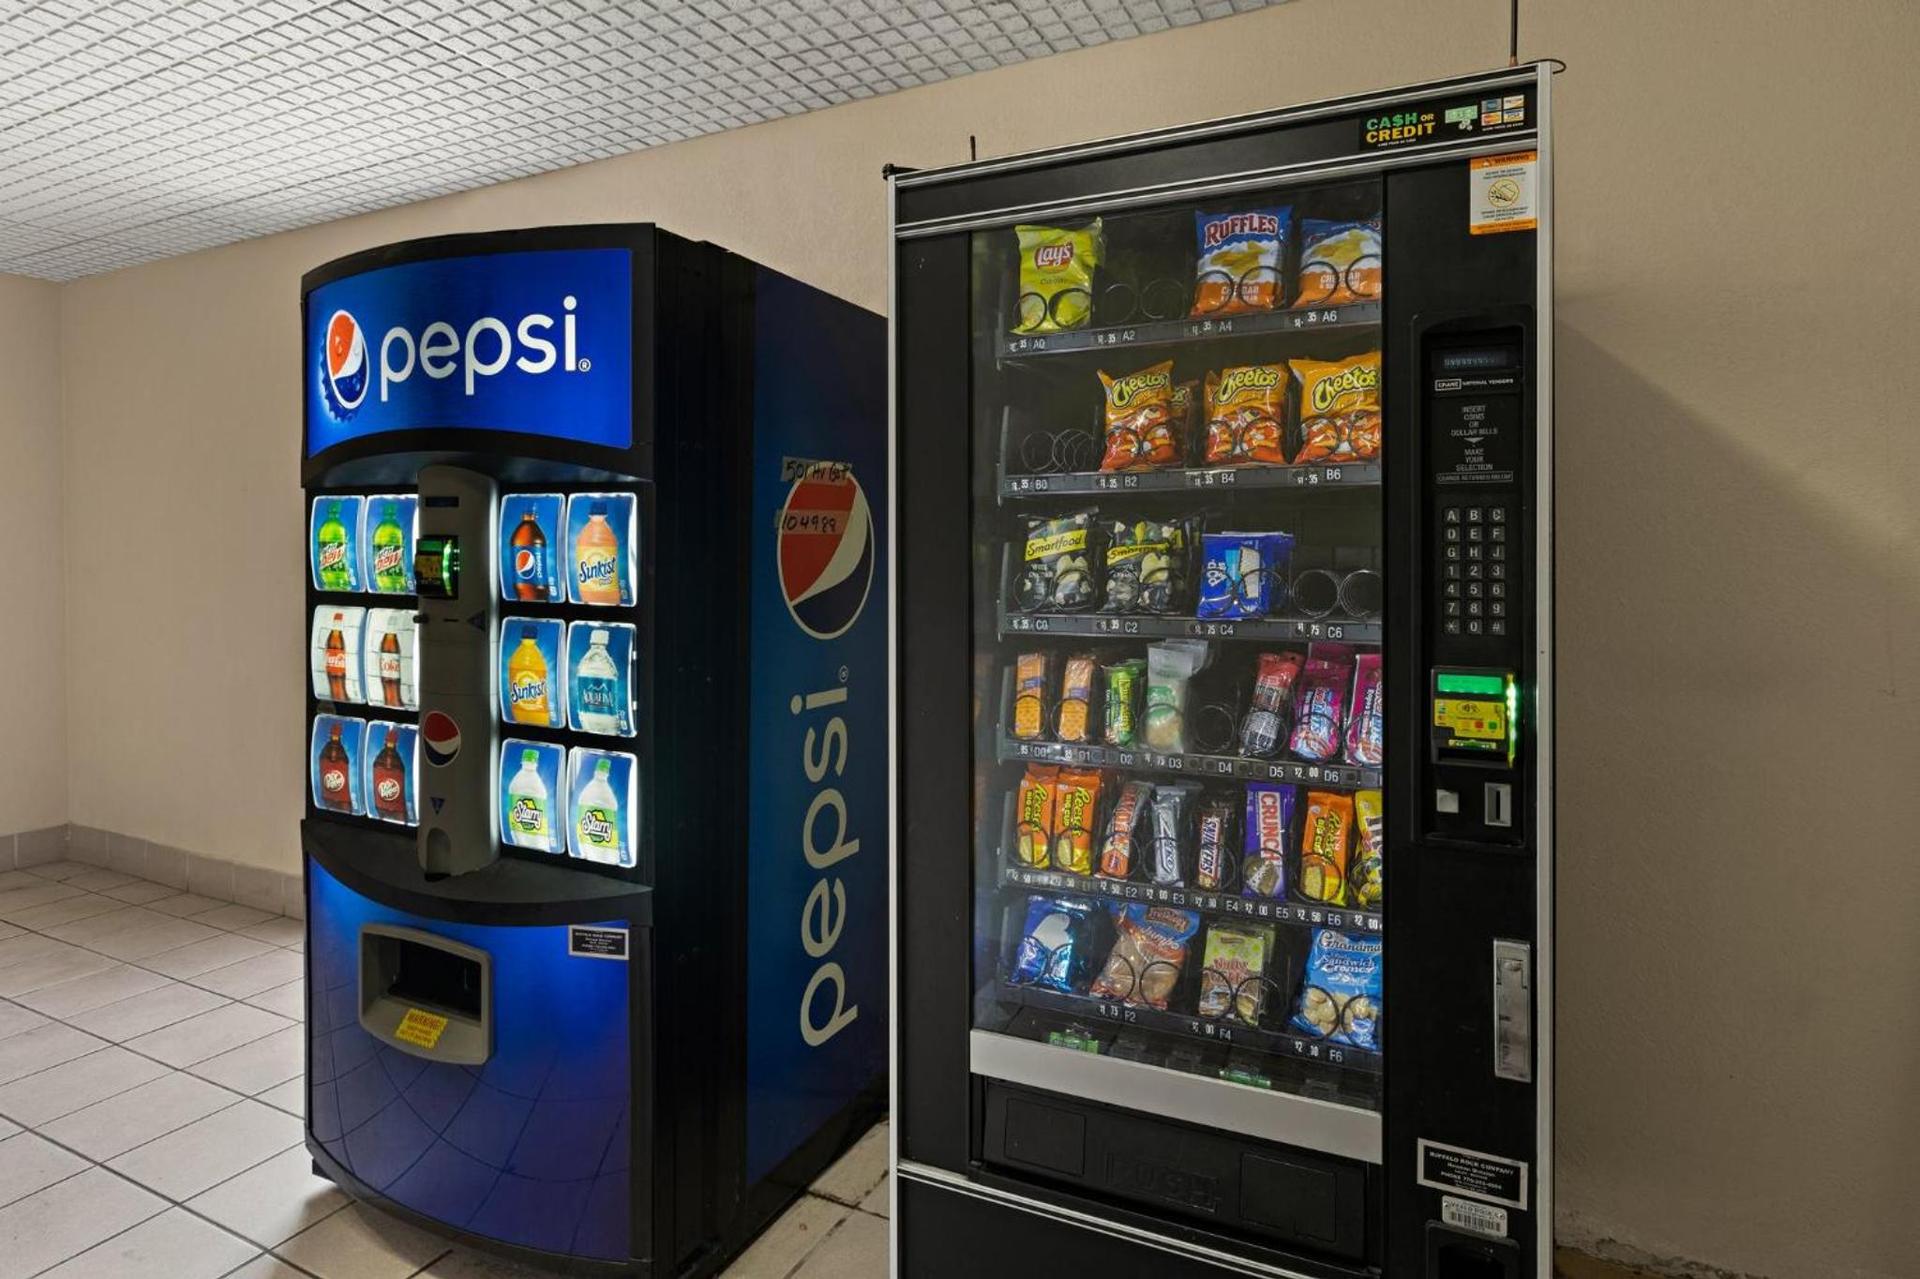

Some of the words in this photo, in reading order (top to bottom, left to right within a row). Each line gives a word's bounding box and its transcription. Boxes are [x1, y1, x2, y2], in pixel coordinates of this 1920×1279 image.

[1421, 113, 1434, 122] OR
[1366, 122, 1436, 143] CREDIT
[1204, 213, 1279, 248] RUFFLES
[1036, 243, 1071, 267] Lay's
[1322, 311, 1337, 322] A6
[1219, 321, 1232, 332] A4
[1122, 330, 1136, 341] A2
[380, 295, 577, 402] pepsi
[1033, 338, 1046, 350] A0
[1112, 372, 1170, 408] Cheetos
[1213, 366, 1280, 404] Cheetos
[1312, 366, 1380, 413] Cheetos
[1221, 473, 1235, 483] B4
[1326, 469, 1341, 481] B6
[1124, 477, 1137, 487] B2
[1447, 510, 1456, 521] A
[1470, 510, 1478, 520] B
[1447, 529, 1456, 539] D
[1470, 529, 1478, 539] E
[1493, 529, 1501, 539] F
[1027, 533, 1082, 556] Smartfood
[1447, 547, 1456, 558] G
[1470, 547, 1478, 557] H
[1492, 547, 1500, 557] J
[580, 557, 617, 583] Sunkist
[1449, 566, 1454, 576] 1
[1470, 566, 1478, 576] 2
[1493, 566, 1500, 576] 3
[1447, 584, 1455, 594] 4
[1470, 584, 1478, 595] 5
[1493, 585, 1500, 595] 6
[1448, 602, 1455, 613] 7
[1470, 603, 1478, 613] 8
[1493, 603, 1500, 614] 9
[1125, 621, 1137, 633] C2
[1220, 624, 1234, 635] C4
[1328, 627, 1343, 638] C6
[1470, 622, 1478, 632] 0
[510, 683, 546, 704] Sunkist
[1079, 751, 1090, 760] D1
[1120, 754, 1133, 765] D2
[1169, 758, 1182, 769] D3
[1219, 762, 1232, 773] D4
[1269, 766, 1284, 777] D5
[1324, 771, 1339, 783] D6
[513, 800, 543, 829] Starry
[582, 813, 613, 841] Starry
[1260, 793, 1280, 861] CRUNCH
[1201, 817, 1217, 877] SNICKERS
[791, 687, 860, 1047] pepsi
[1125, 885, 1138, 898] E2
[1173, 893, 1185, 904] E3
[1226, 901, 1239, 912] E4
[1275, 907, 1289, 919] E5
[1327, 914, 1341, 926] E6
[1124, 1011, 1137, 1023] F2
[1219, 1028, 1232, 1041] F4
[1329, 1050, 1343, 1062] F6
